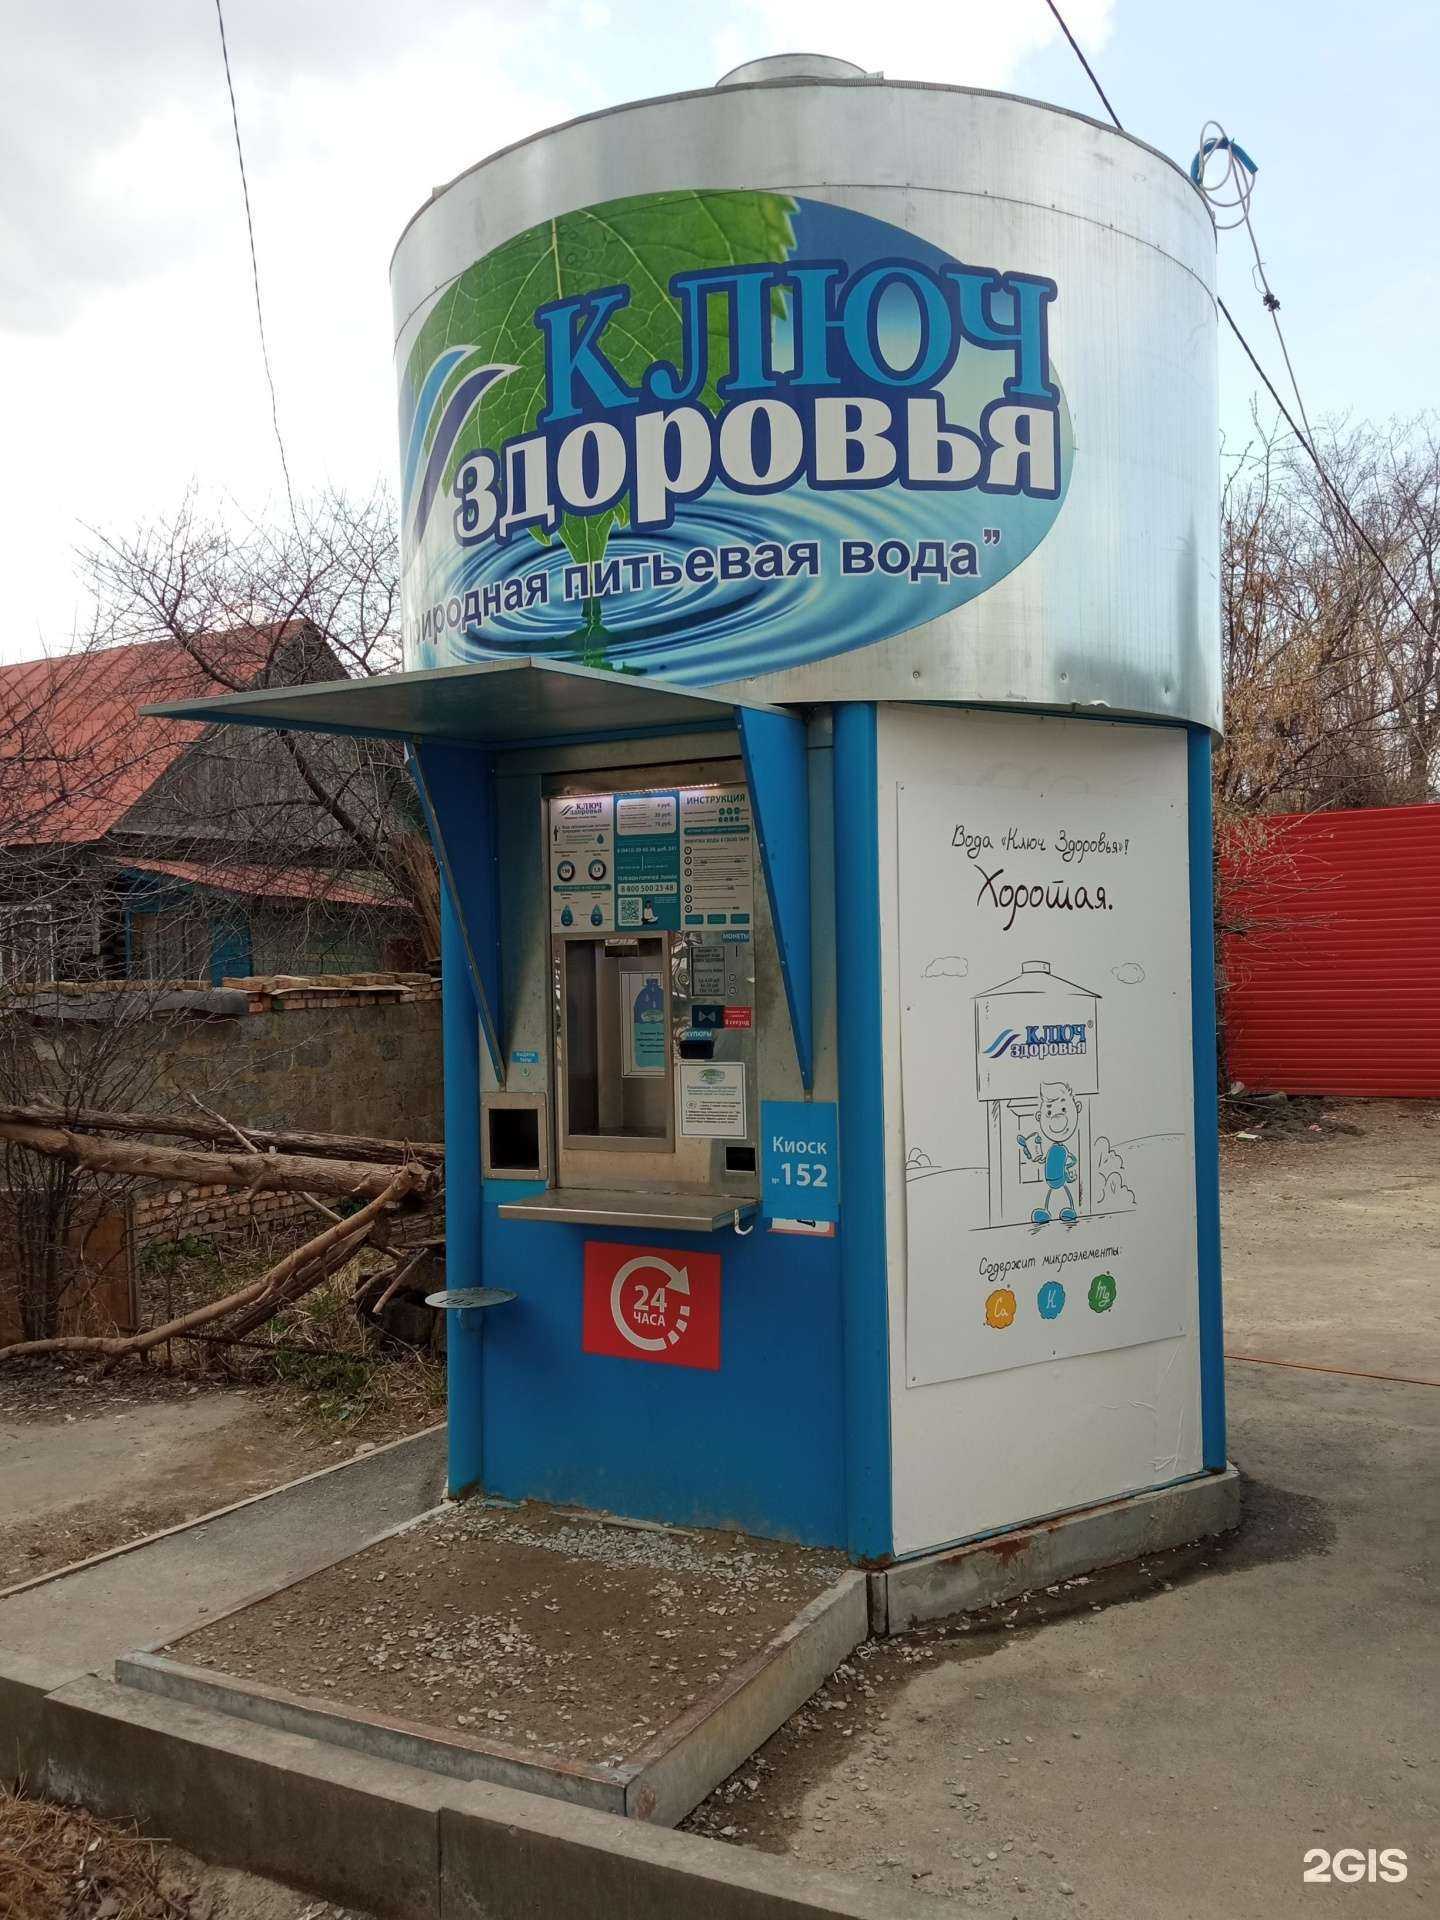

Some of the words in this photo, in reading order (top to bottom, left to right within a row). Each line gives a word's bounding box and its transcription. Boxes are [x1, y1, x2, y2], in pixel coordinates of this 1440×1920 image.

[537, 260, 1056, 424] КЛЮЧ
[454, 395, 1062, 547] здоровья
[563, 538, 820, 603] питьевая
[576, 802, 602, 810] КЛЮЧ
[686, 793, 745, 805] ИНСТРУКЦИЯ
[952, 824, 994, 859] Вода
[974, 864, 1113, 931] Хорошая.
[1026, 1024, 1087, 1045] КЛЮЧ
[1010, 1041, 1087, 1060] здоровья
[772, 1136, 827, 1155] Киоск
[979, 1257, 1036, 1281] Содержит
[633, 1285, 668, 1313] 24
[633, 1311, 666, 1327] ЧАСА
